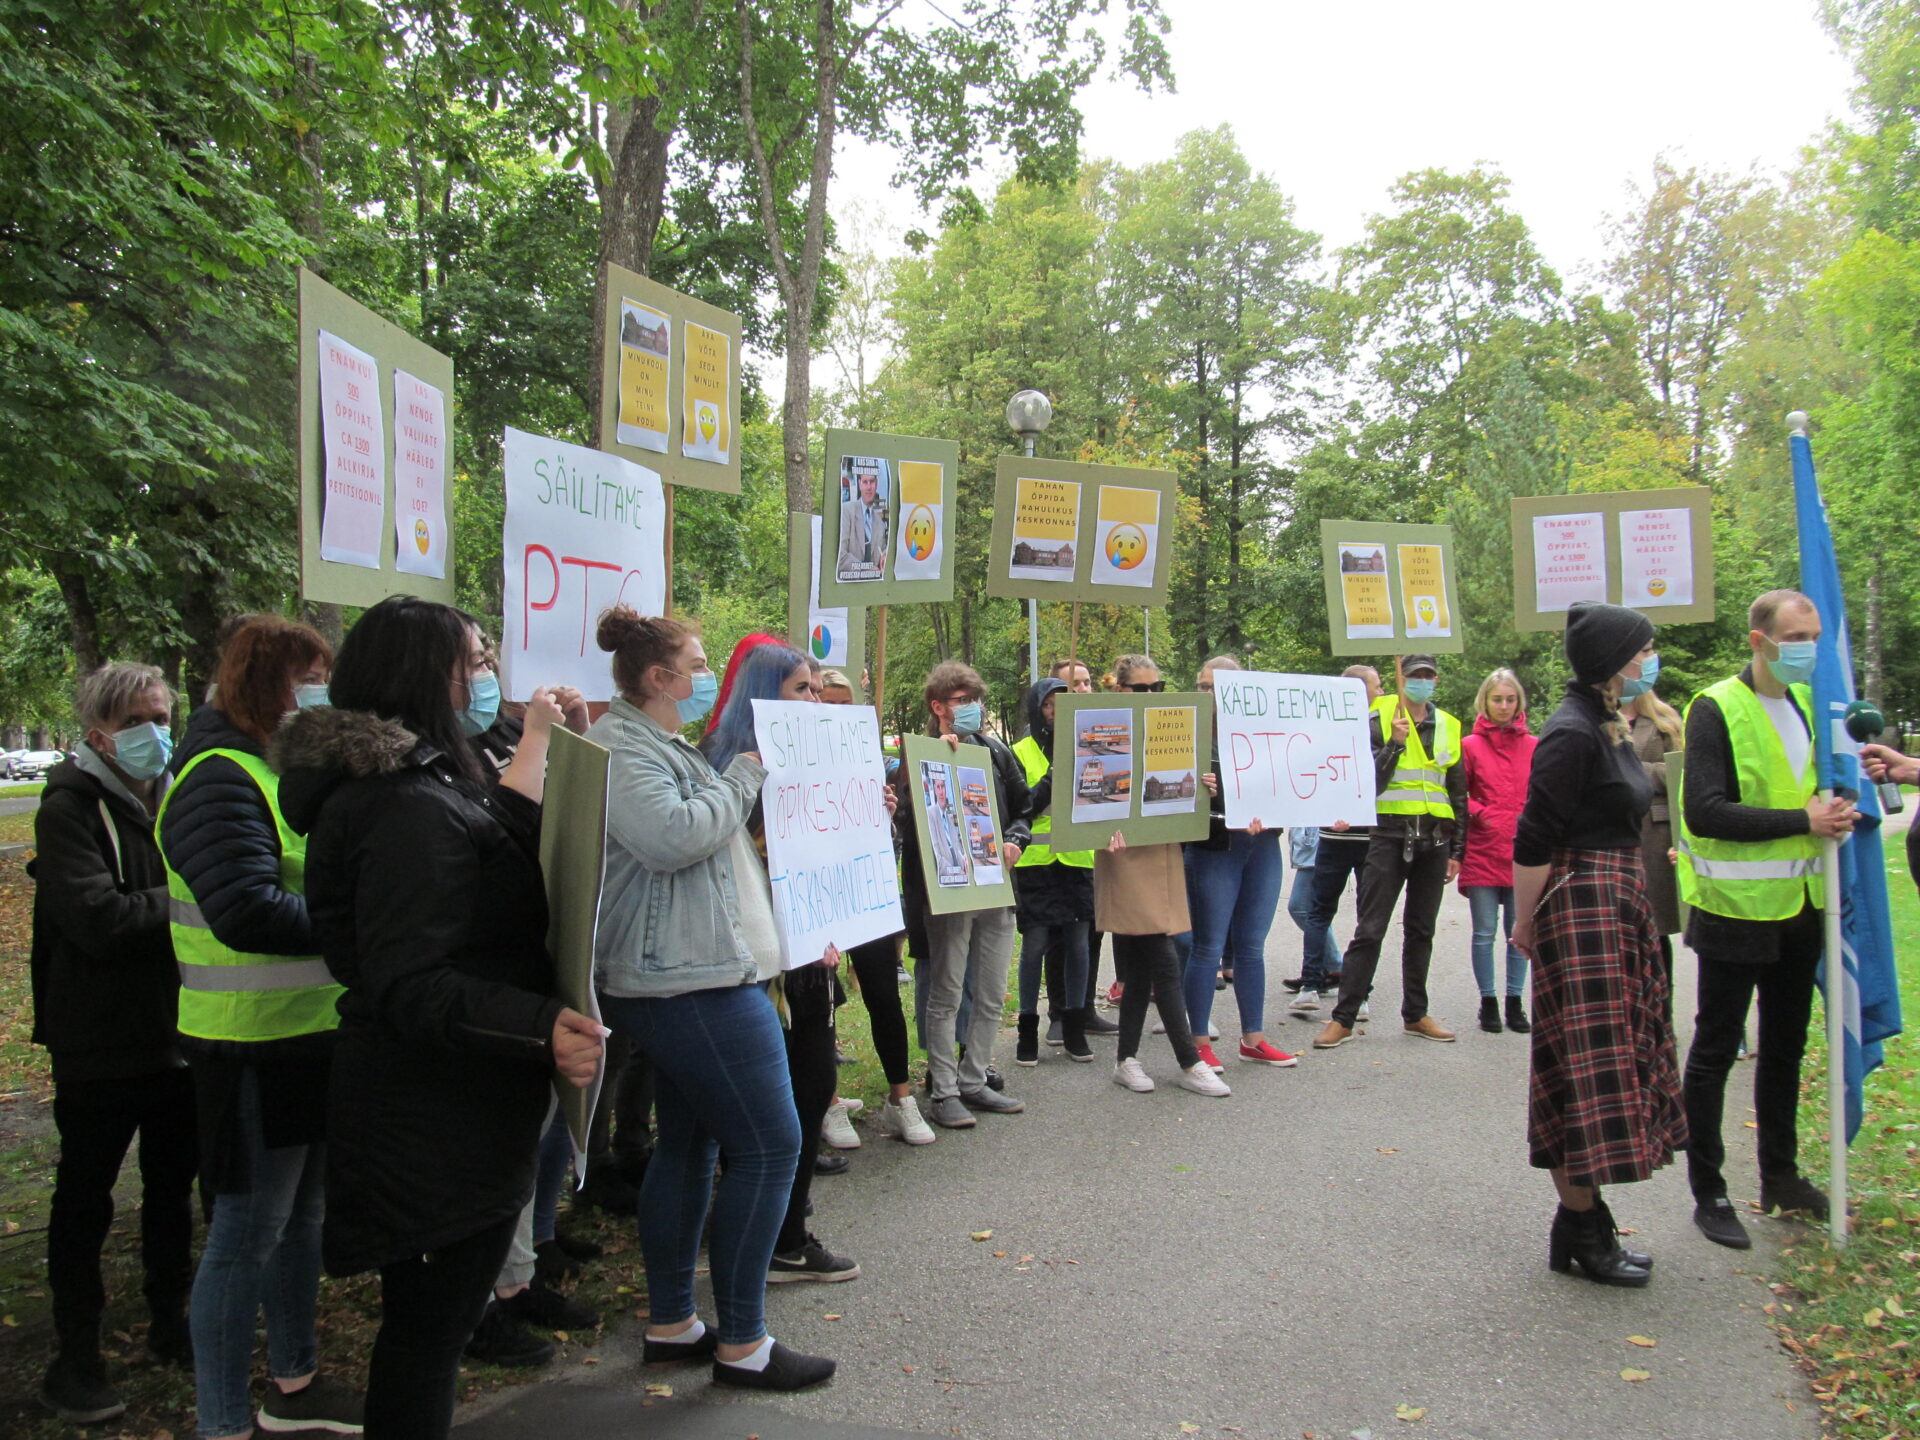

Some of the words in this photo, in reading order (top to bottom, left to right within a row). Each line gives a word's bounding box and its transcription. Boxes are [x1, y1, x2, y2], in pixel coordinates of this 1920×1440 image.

[699, 360, 716, 372] SEDA
[640, 371, 650, 381] ON
[694, 374, 720, 389] MINULT
[635, 385, 654, 398] MINU
[409, 403, 433, 424] NENDE
[636, 415, 655, 428] KODU
[341, 431, 352, 446] CA
[355, 436, 370, 454] 1300
[403, 424, 437, 448] VALIJATE
[337, 455, 375, 480] ALLKIRJA
[416, 477, 424, 488] EI
[1033, 481, 1065, 491] TAHAN
[534, 455, 644, 530] SÄILITAME
[1031, 493, 1065, 502] ÕPPIDA
[1021, 504, 1073, 515] RAHULIKUS
[1016, 516, 1076, 527] KESKKONNAS
[1220, 682, 1268, 717] KÄED
[1277, 688, 1358, 722] EEMALE
[1231, 732, 1362, 800] PTG-ST!
